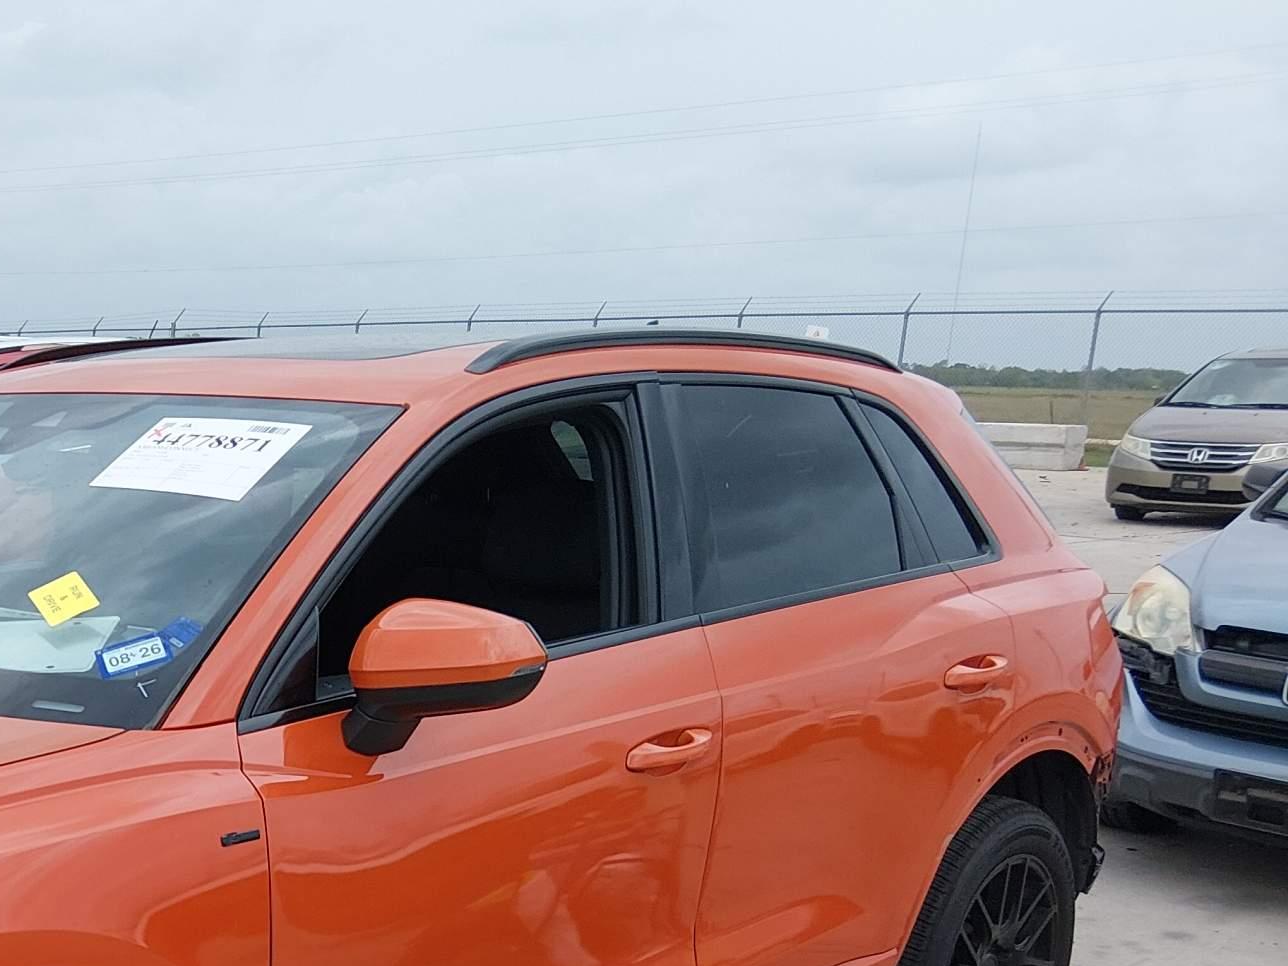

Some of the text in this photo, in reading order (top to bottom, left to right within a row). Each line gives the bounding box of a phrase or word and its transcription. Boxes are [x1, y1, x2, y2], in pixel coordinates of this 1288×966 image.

[152, 432, 272, 453] 44778871
[108, 653, 131, 667] 08
[139, 643, 161, 658] 26
